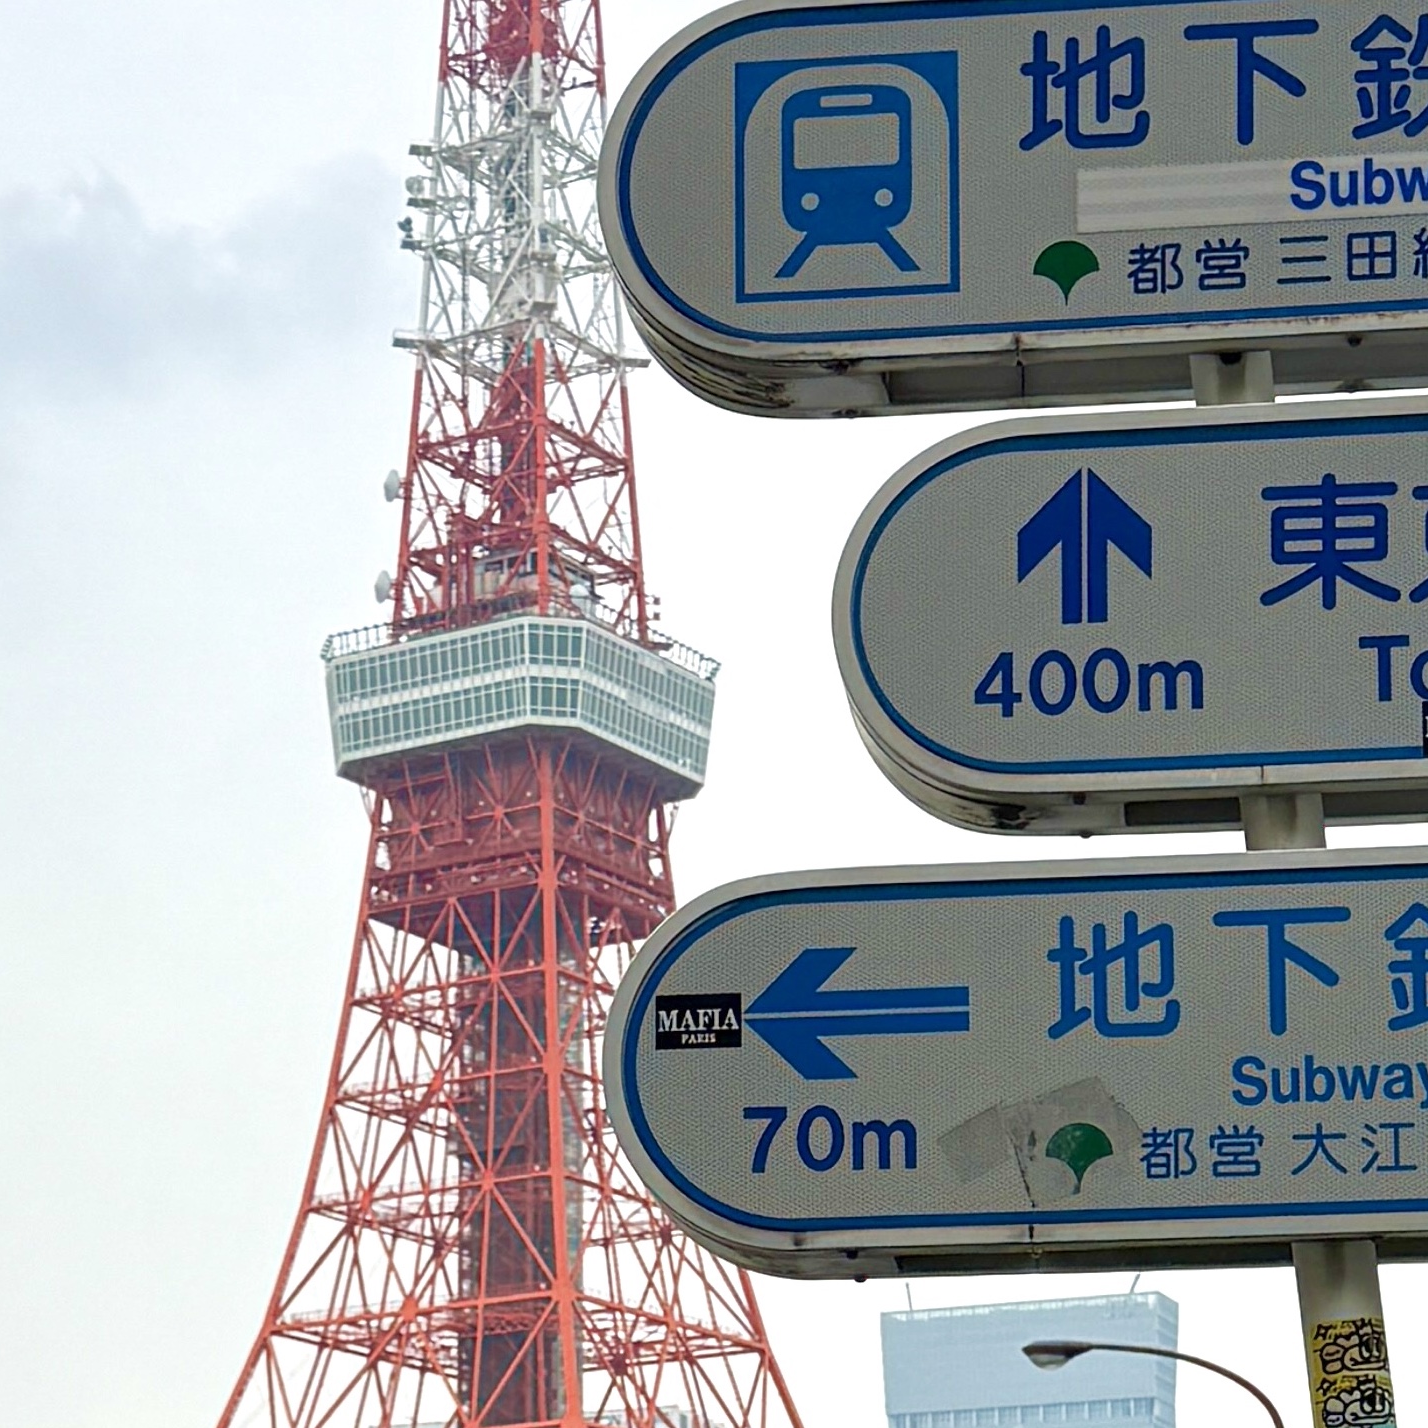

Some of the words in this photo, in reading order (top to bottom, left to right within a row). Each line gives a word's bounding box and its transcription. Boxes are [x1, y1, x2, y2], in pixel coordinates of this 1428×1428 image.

[974, 647, 1204, 718] 400m
[657, 1008, 740, 1032] MAFIA
[681, 1033, 717, 1045] PARIS
[743, 1105, 918, 1175] 70m
